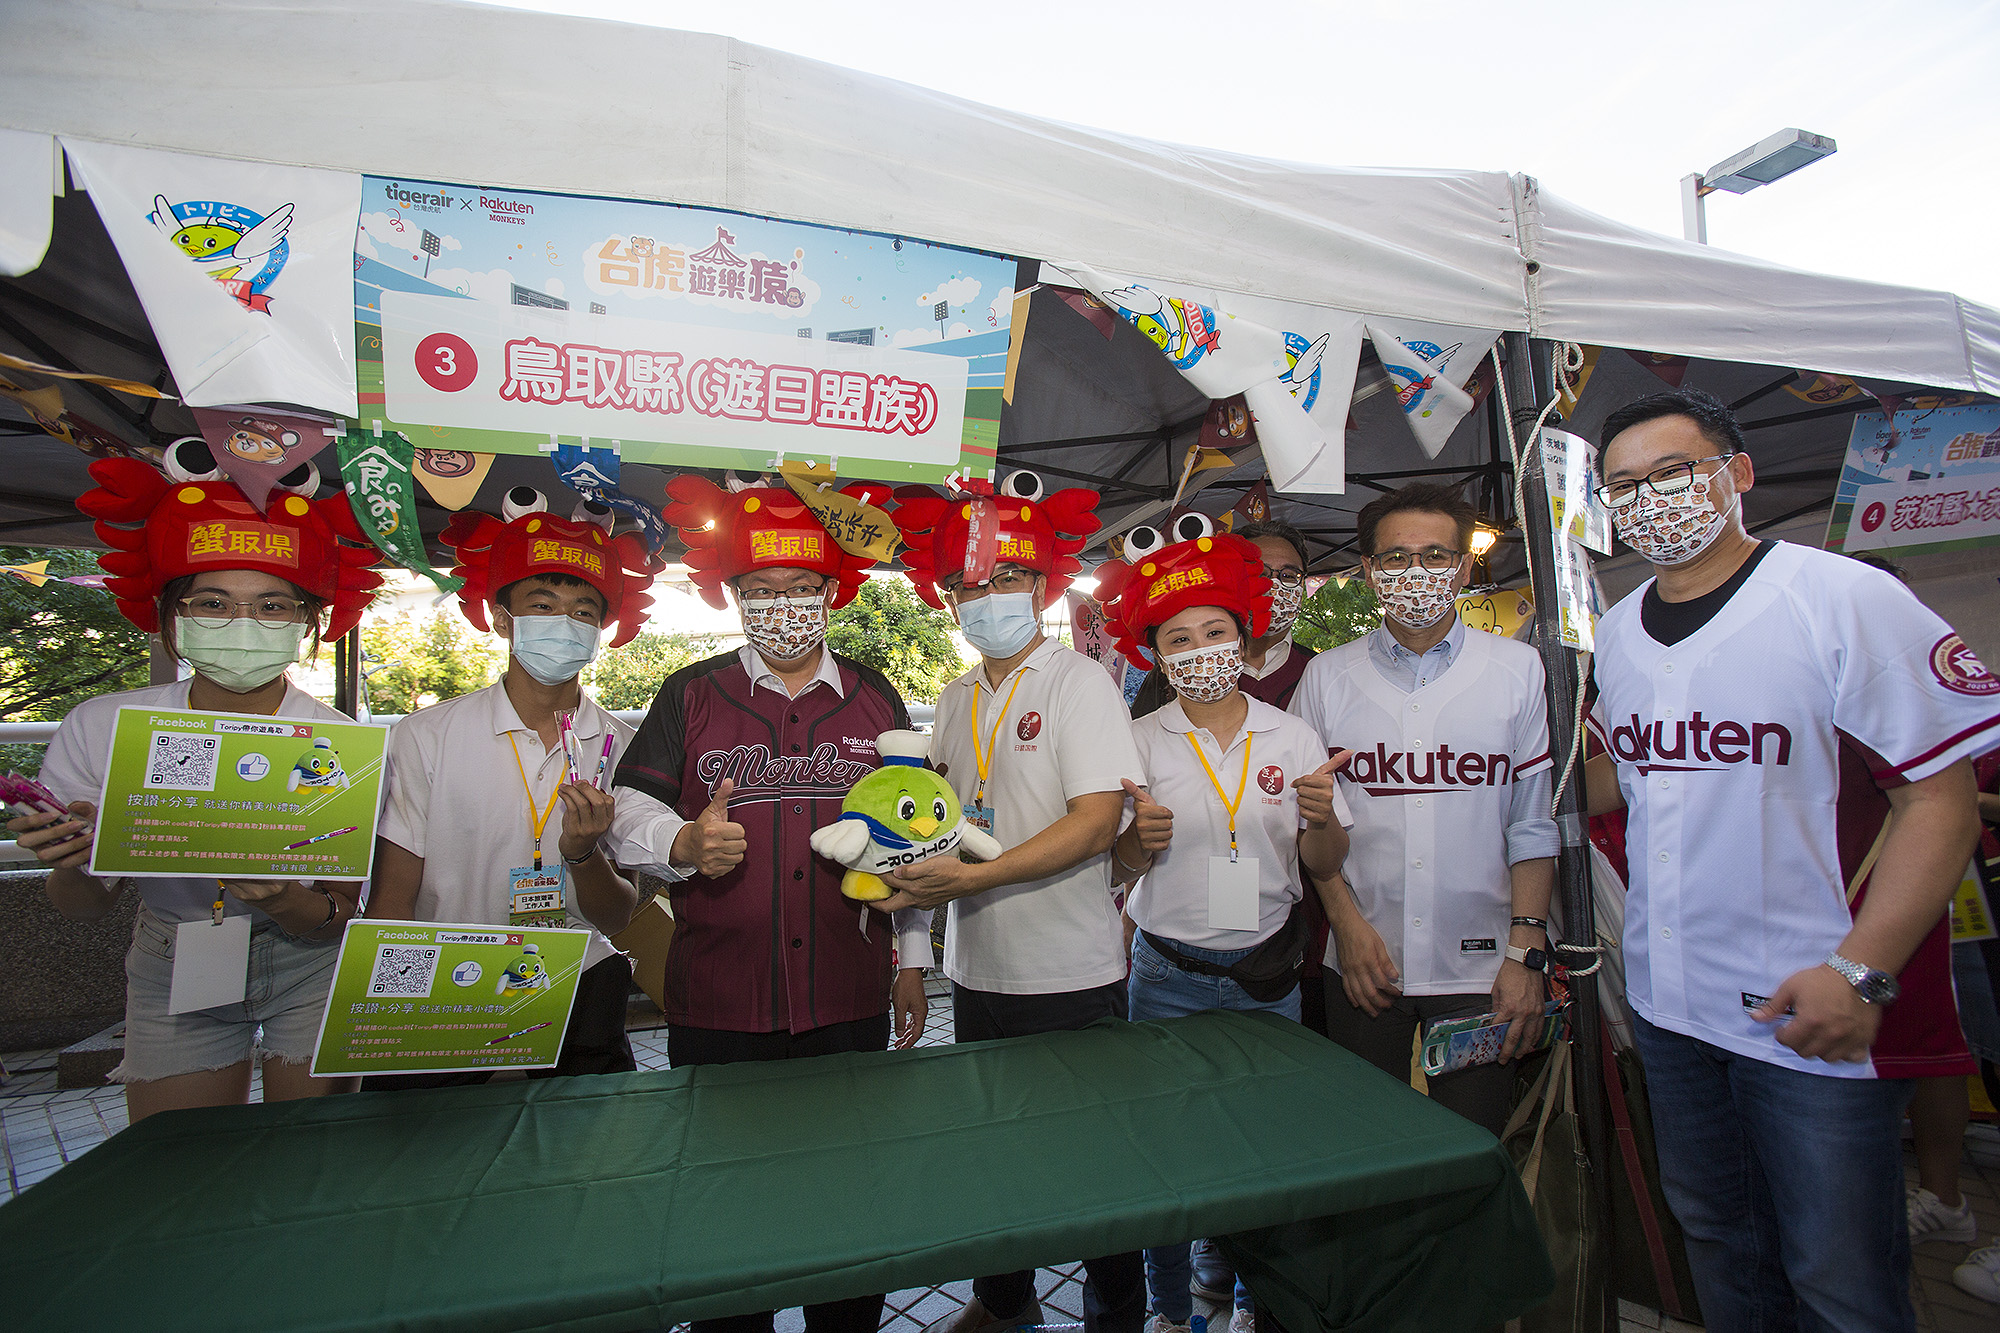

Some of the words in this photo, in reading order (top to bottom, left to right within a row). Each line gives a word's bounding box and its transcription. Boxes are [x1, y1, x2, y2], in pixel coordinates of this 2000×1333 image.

[182, 202, 252, 220] トリピー
[385, 182, 454, 208] tigerair
[480, 196, 534, 215] Rakuten
[489, 214, 526, 225] MONKEYS
[433, 347, 457, 377] 3
[1867, 508, 1880, 524] 4
[190, 523, 295, 560] 蟹取県
[752, 530, 821, 559] 蟹取県
[996, 538, 1036, 560] 取県
[533, 539, 603, 575] 蟹取県
[149, 715, 207, 729] Facebook
[842, 736, 877, 747] Rakute
[1611, 711, 1793, 766] akuten
[697, 743, 878, 790] Monkey
[376, 930, 430, 941] Facebook
